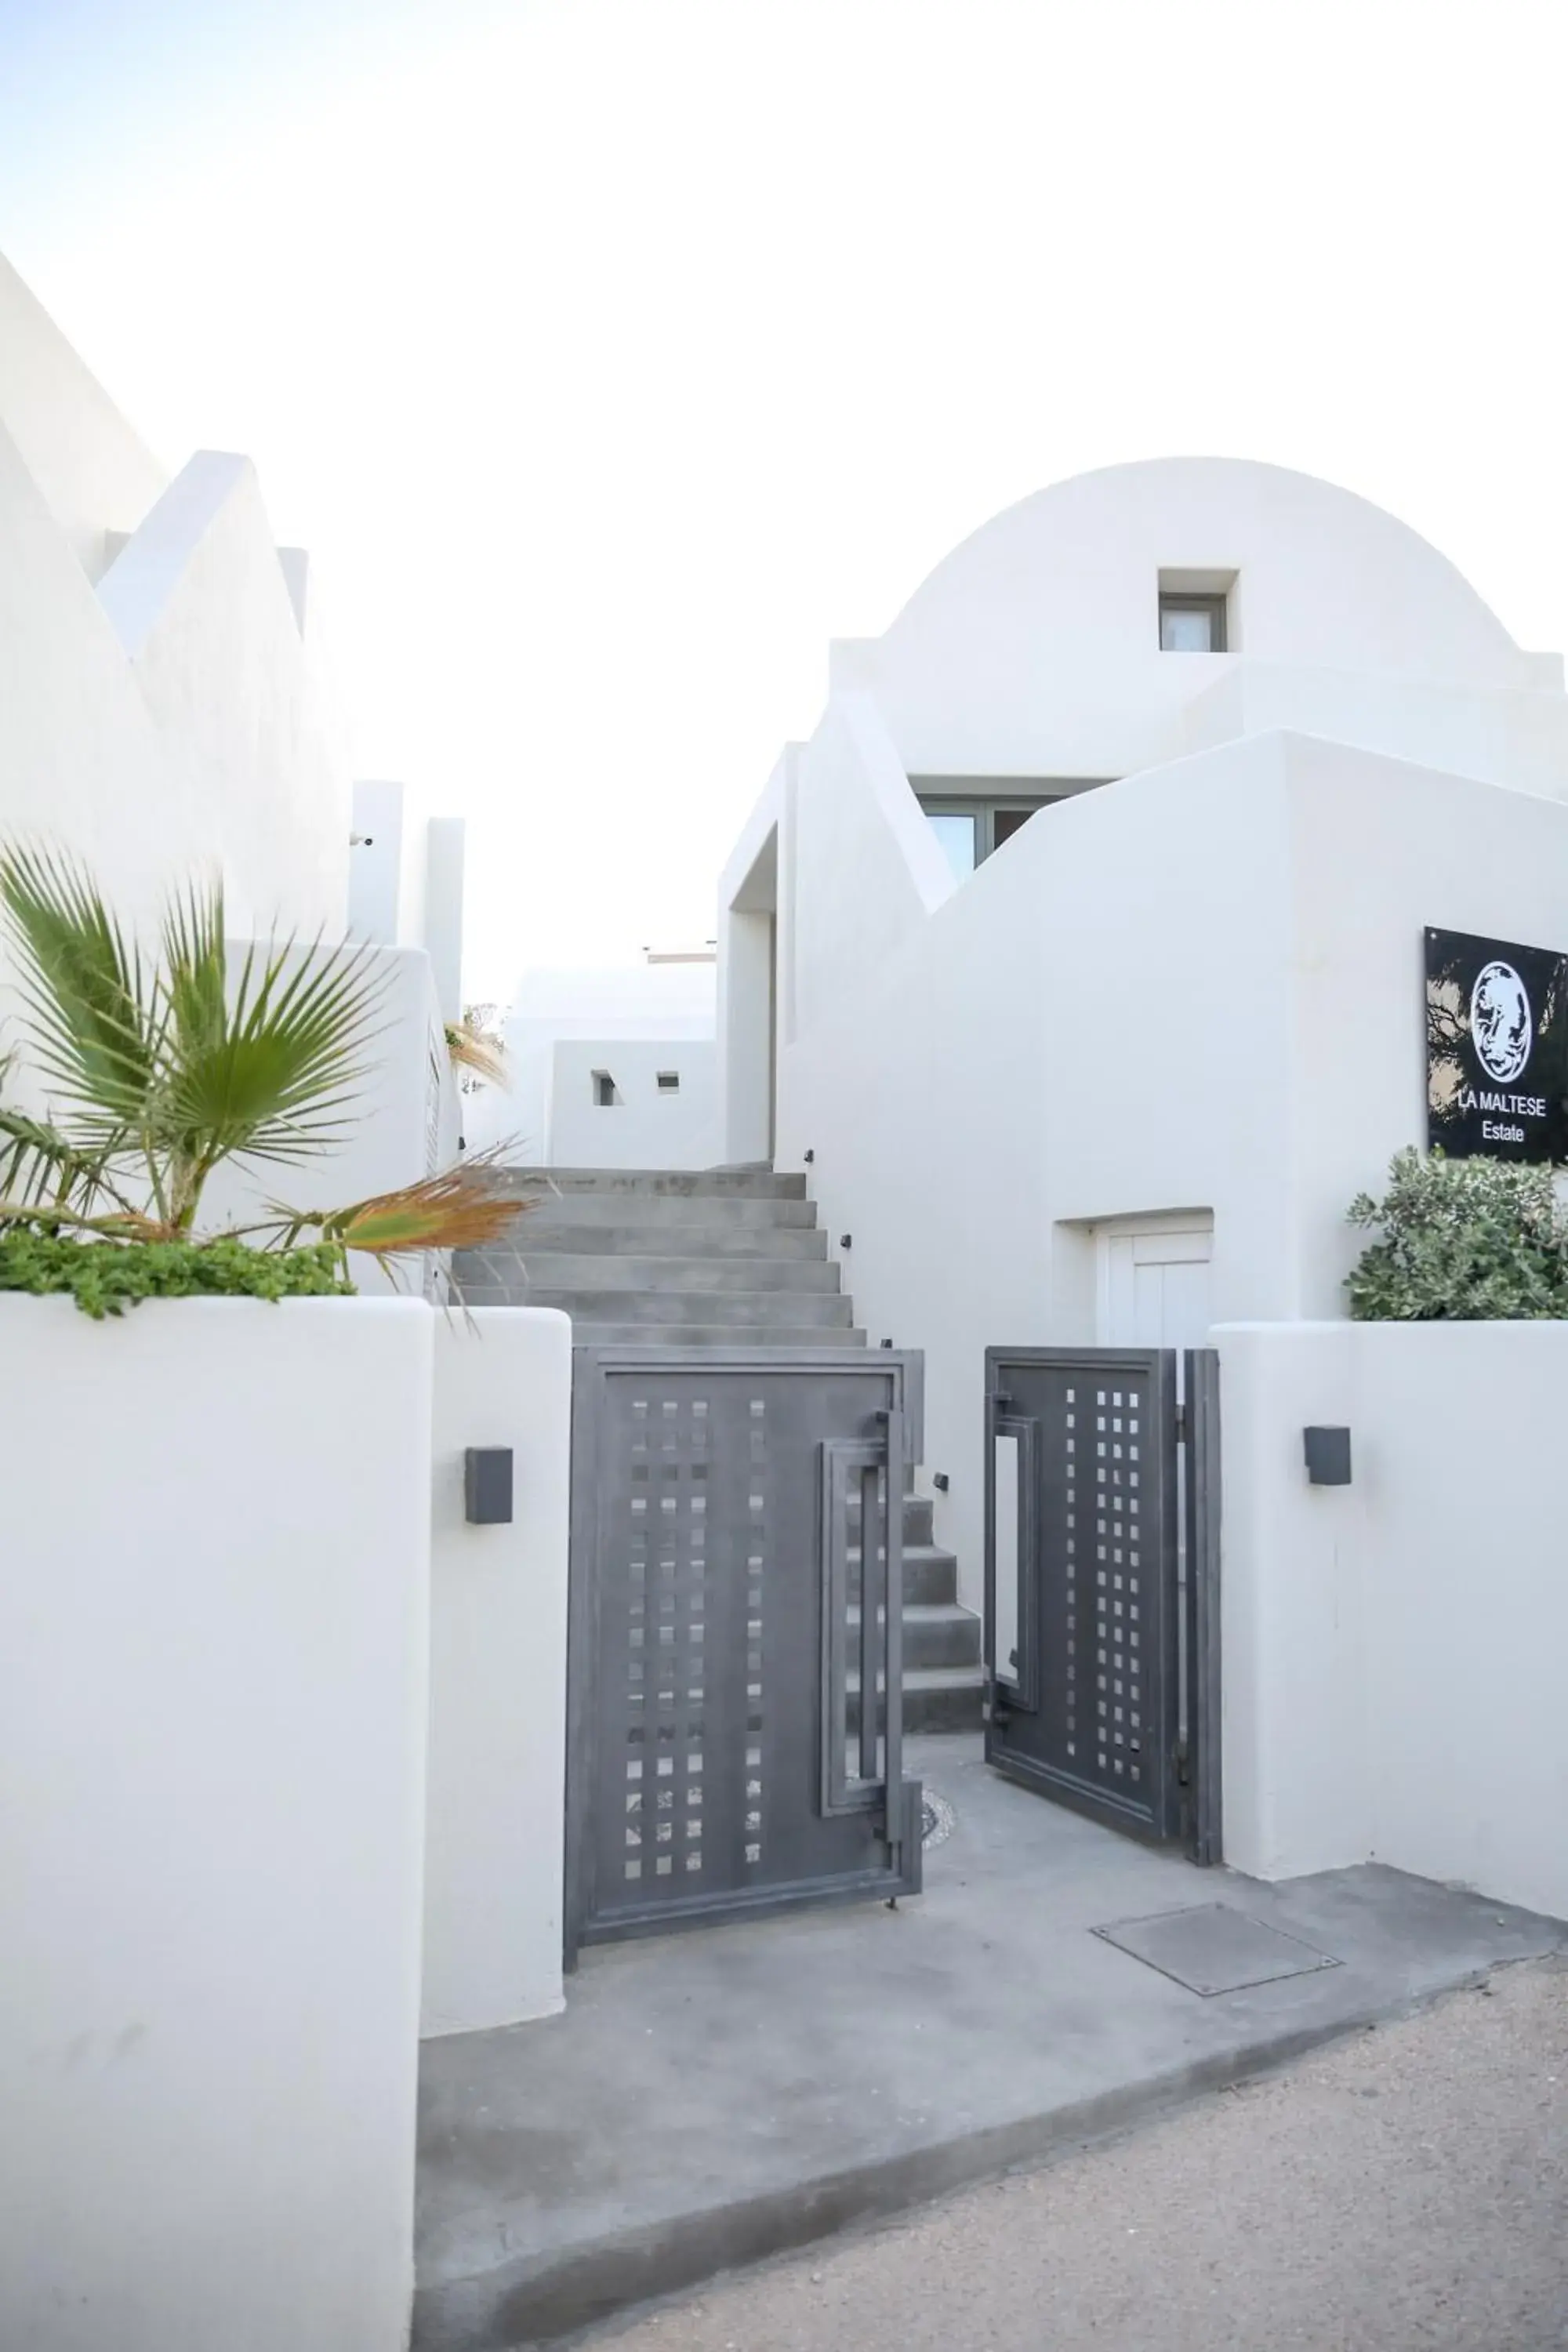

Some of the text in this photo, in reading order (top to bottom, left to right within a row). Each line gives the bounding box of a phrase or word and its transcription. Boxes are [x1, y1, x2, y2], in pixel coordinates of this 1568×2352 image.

[1458, 1089, 1546, 1116] LA MALTESE
[1483, 1120, 1524, 1142] Estate
